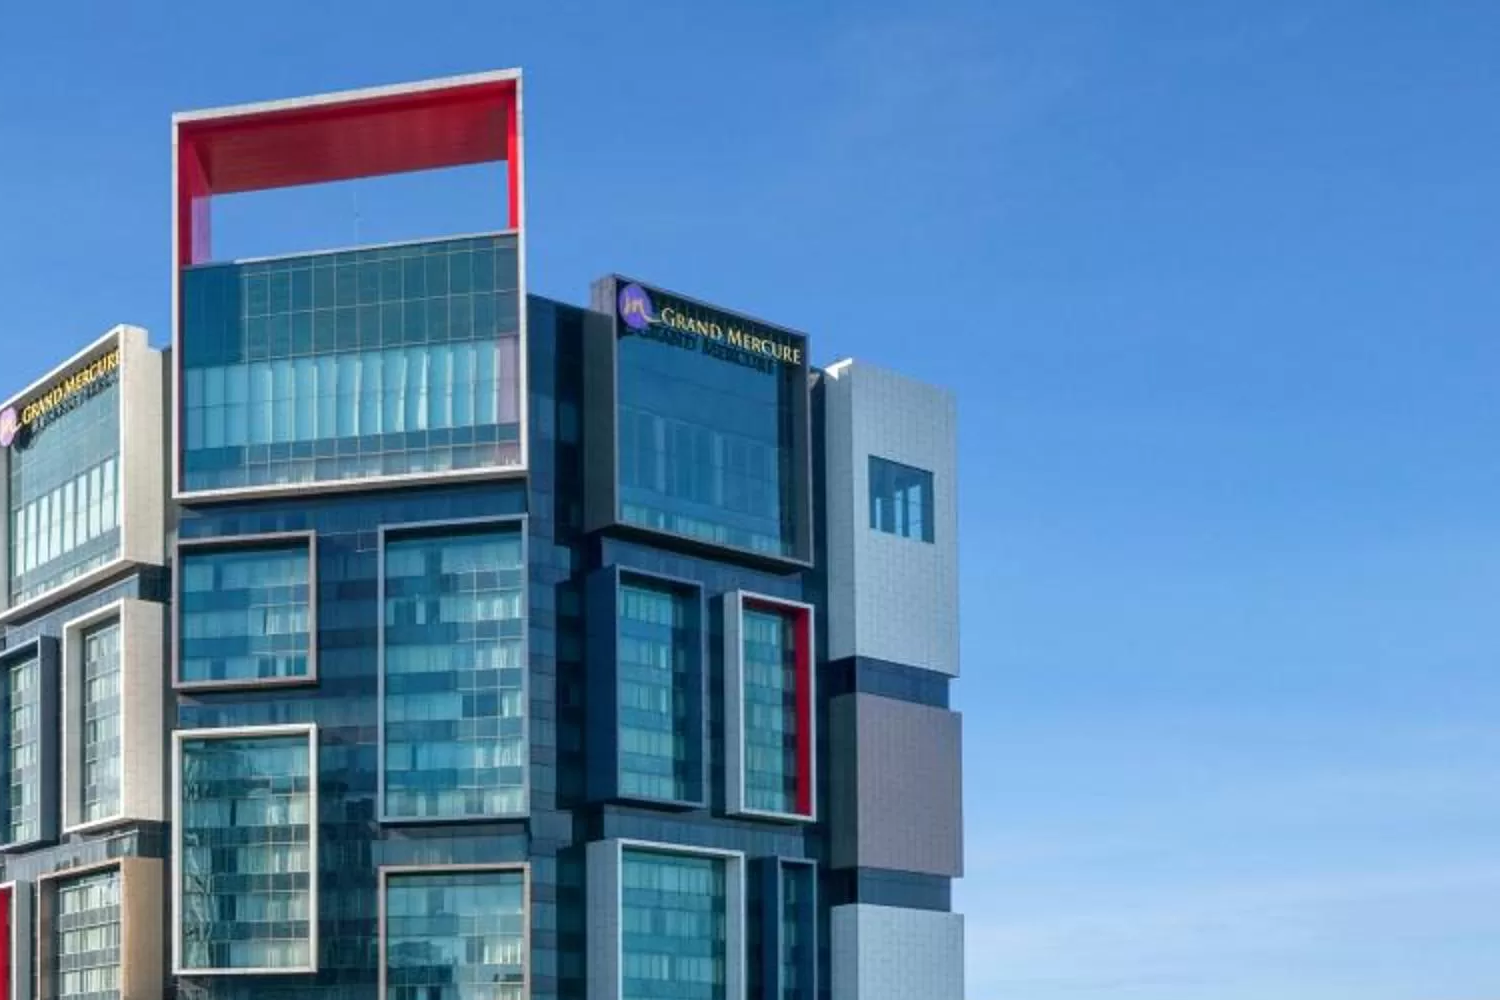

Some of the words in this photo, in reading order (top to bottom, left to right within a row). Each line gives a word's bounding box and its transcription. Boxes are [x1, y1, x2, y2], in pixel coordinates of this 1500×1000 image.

[662, 307, 724, 339] GRAND
[728, 328, 801, 365] MERCURE
[22, 388, 63, 425] GRAND
